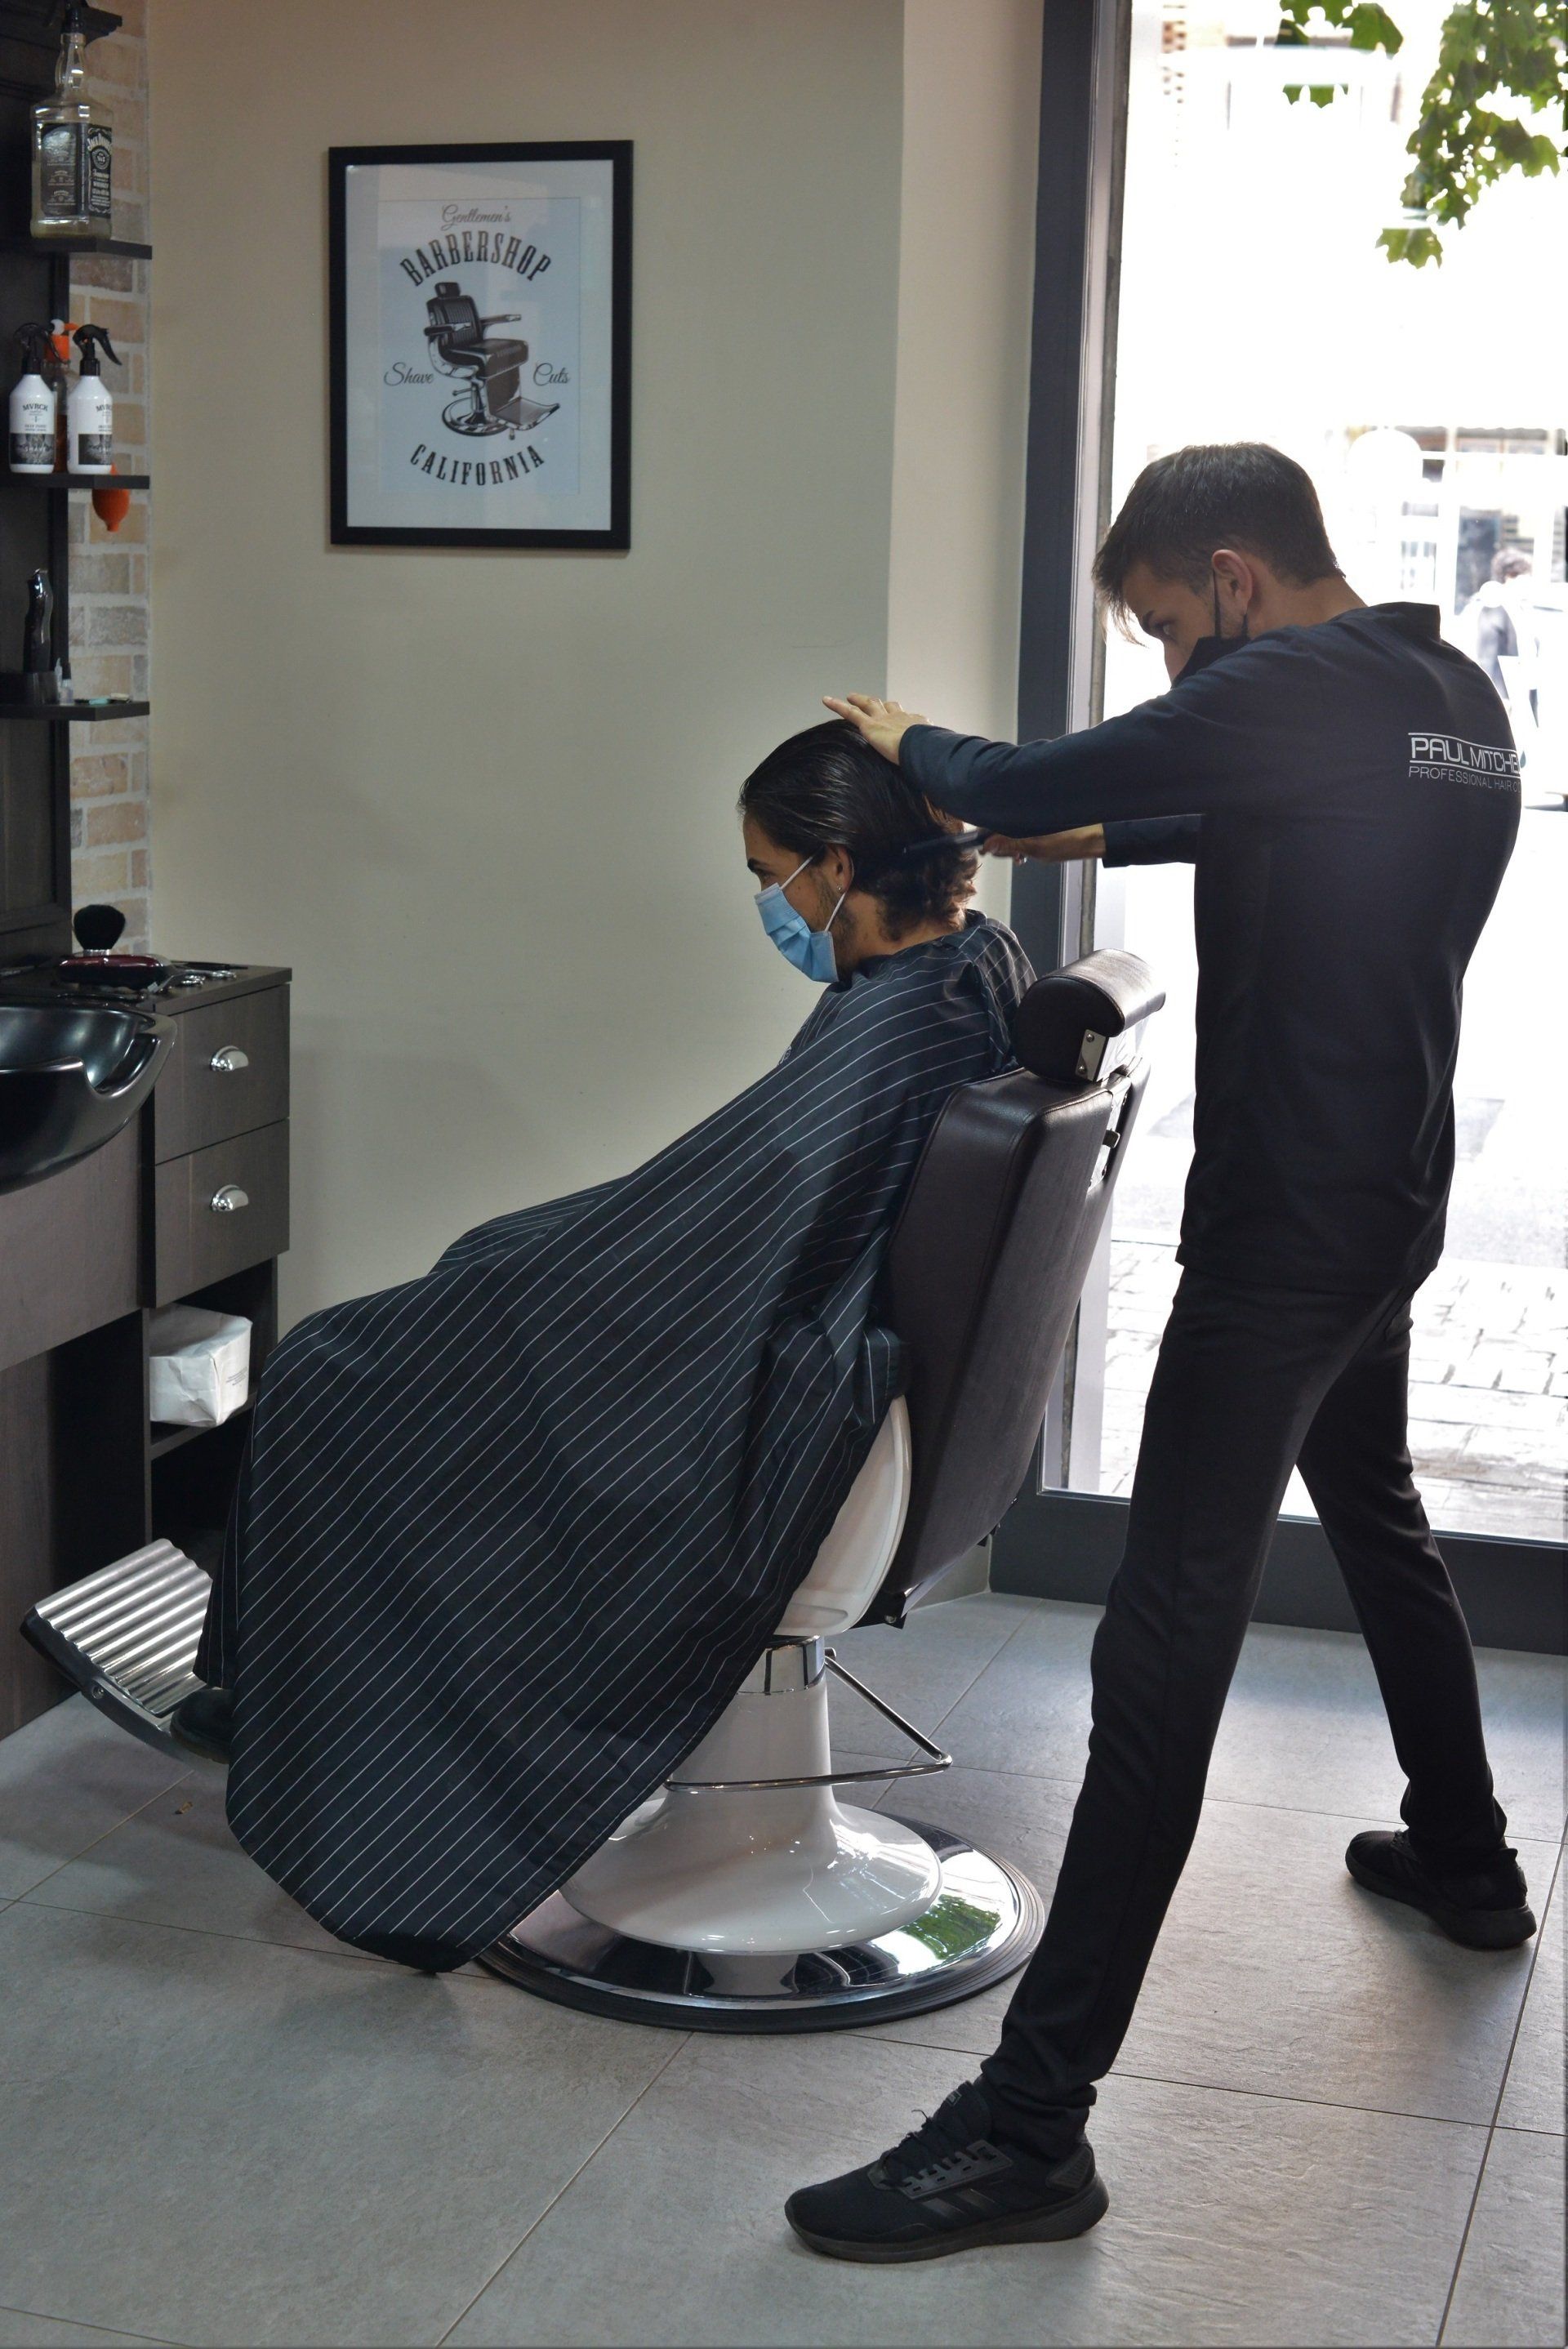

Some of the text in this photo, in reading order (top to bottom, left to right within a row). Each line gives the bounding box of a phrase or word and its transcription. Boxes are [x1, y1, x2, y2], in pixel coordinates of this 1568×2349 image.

[440, 204, 512, 231] Gentlemen's
[399, 230, 552, 287] BARBERSHOP
[383, 362, 434, 386] Shave
[533, 363, 570, 386] Cuts
[410, 444, 545, 486] CALIFORNIA
[1411, 737, 1469, 765] PAUL
[1408, 765, 1492, 789] PROFESSIONAL
[1494, 780, 1511, 791] HAIR
